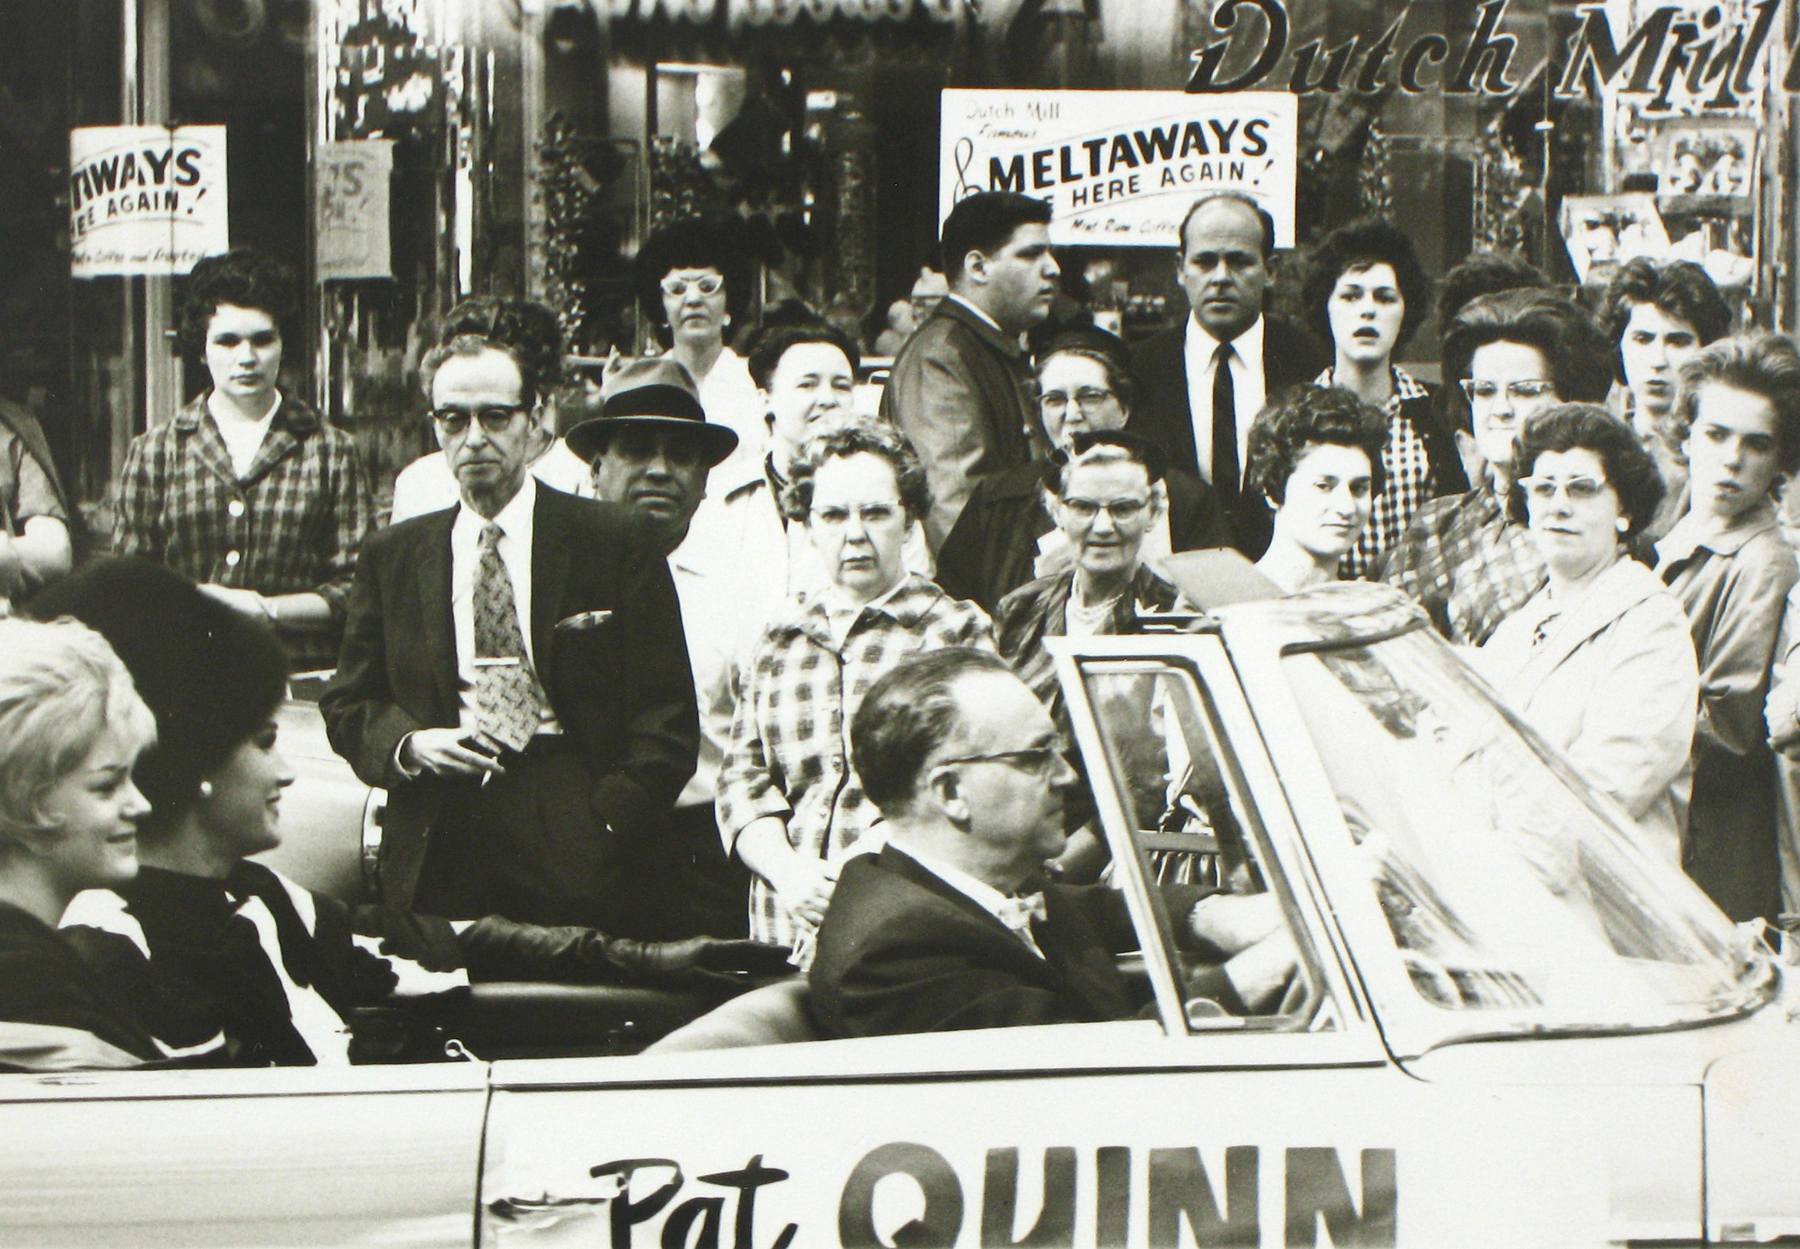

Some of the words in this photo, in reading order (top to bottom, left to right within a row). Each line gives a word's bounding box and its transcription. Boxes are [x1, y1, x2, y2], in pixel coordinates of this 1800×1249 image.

[1185, 0, 1520, 97] Dutch
[1027, 101, 1060, 122] Mill
[989, 118, 1270, 193] MELTAWAYS
[1072, 174, 1141, 207] HERE
[1160, 159, 1275, 188] AGAIN!
[107, 188, 207, 220] AGAIN!
[589, 1154, 799, 1249] Pat
[838, 1141, 1396, 1249] QUINN
